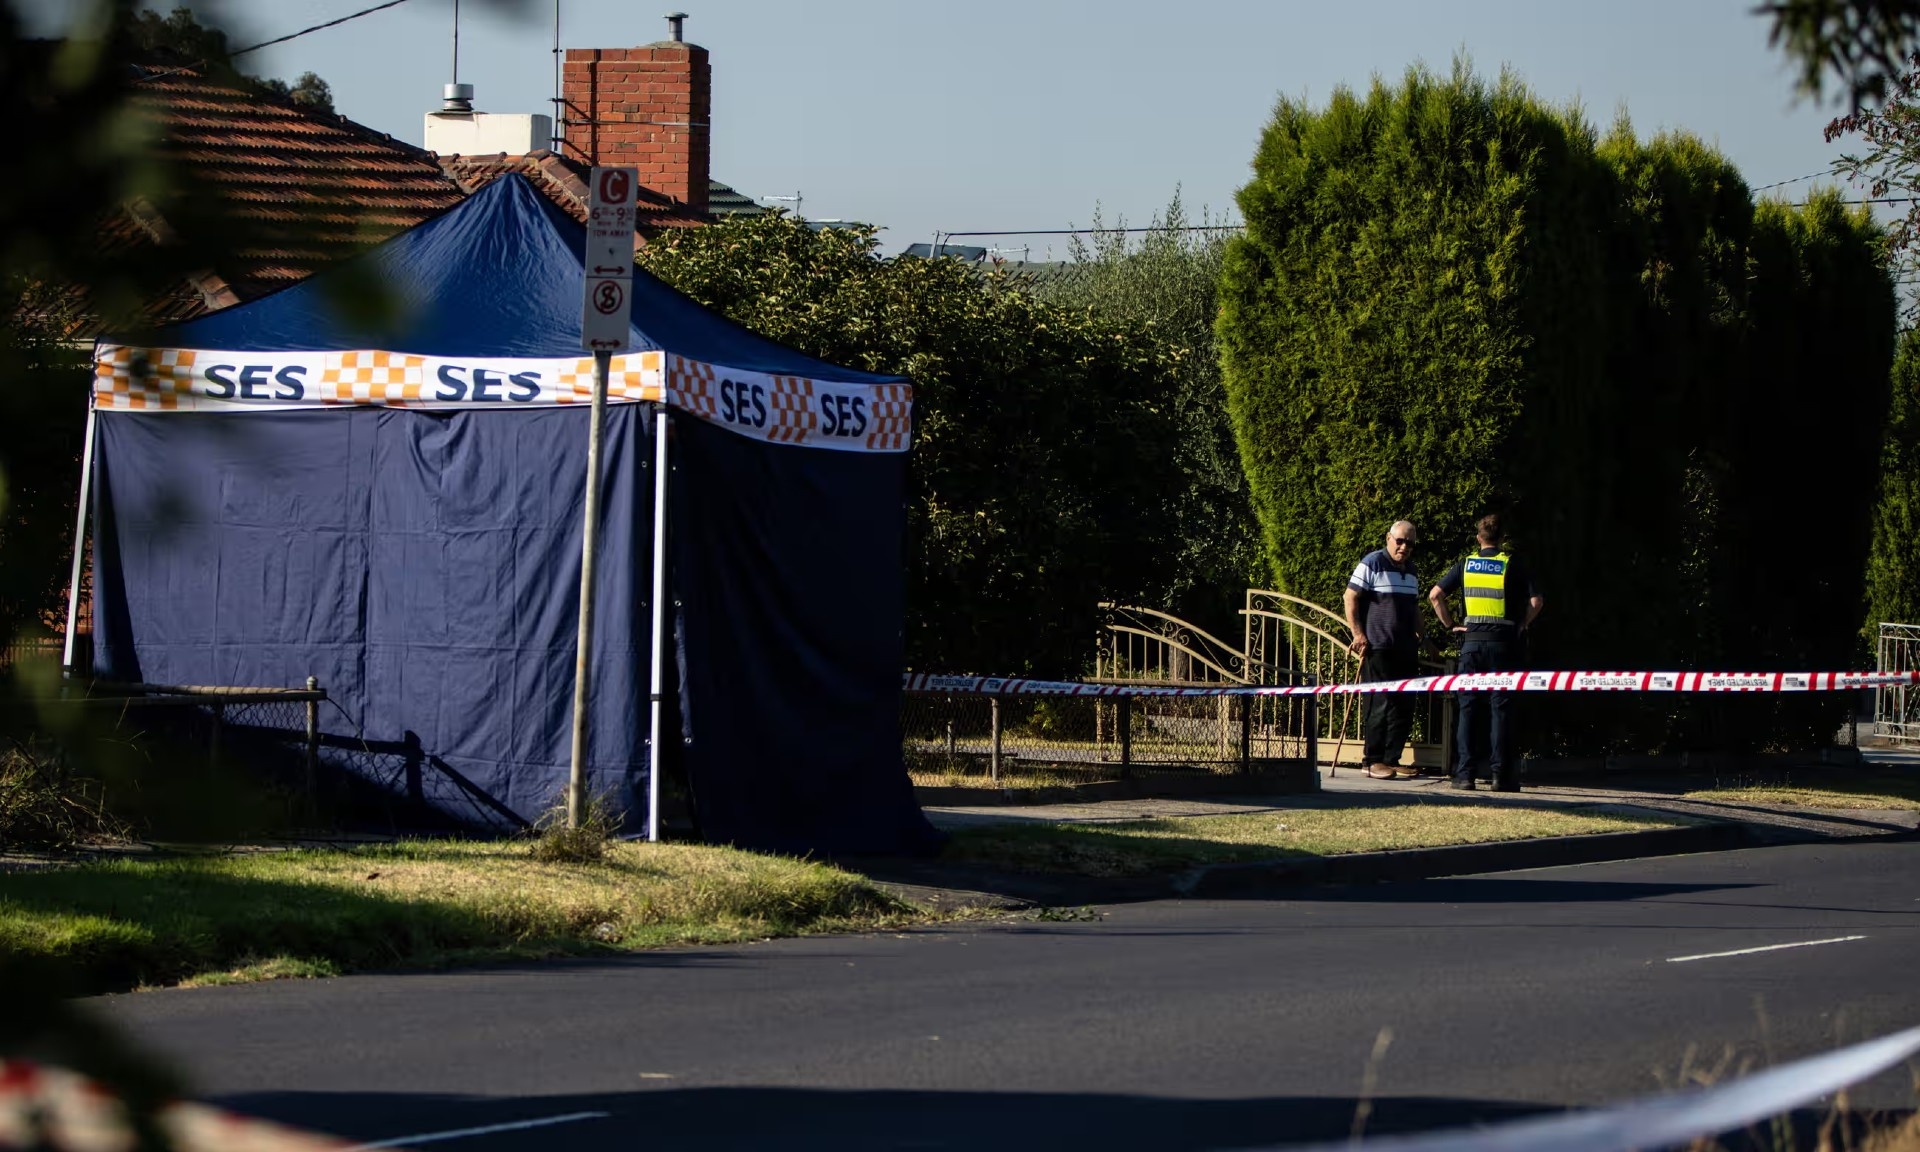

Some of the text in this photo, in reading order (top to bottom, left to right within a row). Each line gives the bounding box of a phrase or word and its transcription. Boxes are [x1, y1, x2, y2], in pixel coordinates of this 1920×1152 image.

[606, 171, 623, 201] C
[204, 365, 307, 400] SES
[436, 365, 541, 401] SES
[720, 379, 767, 428] SES
[820, 393, 867, 438] SES
[1467, 560, 1502, 572] Police
[1708, 679, 1769, 687] RESTRICTED AREA
